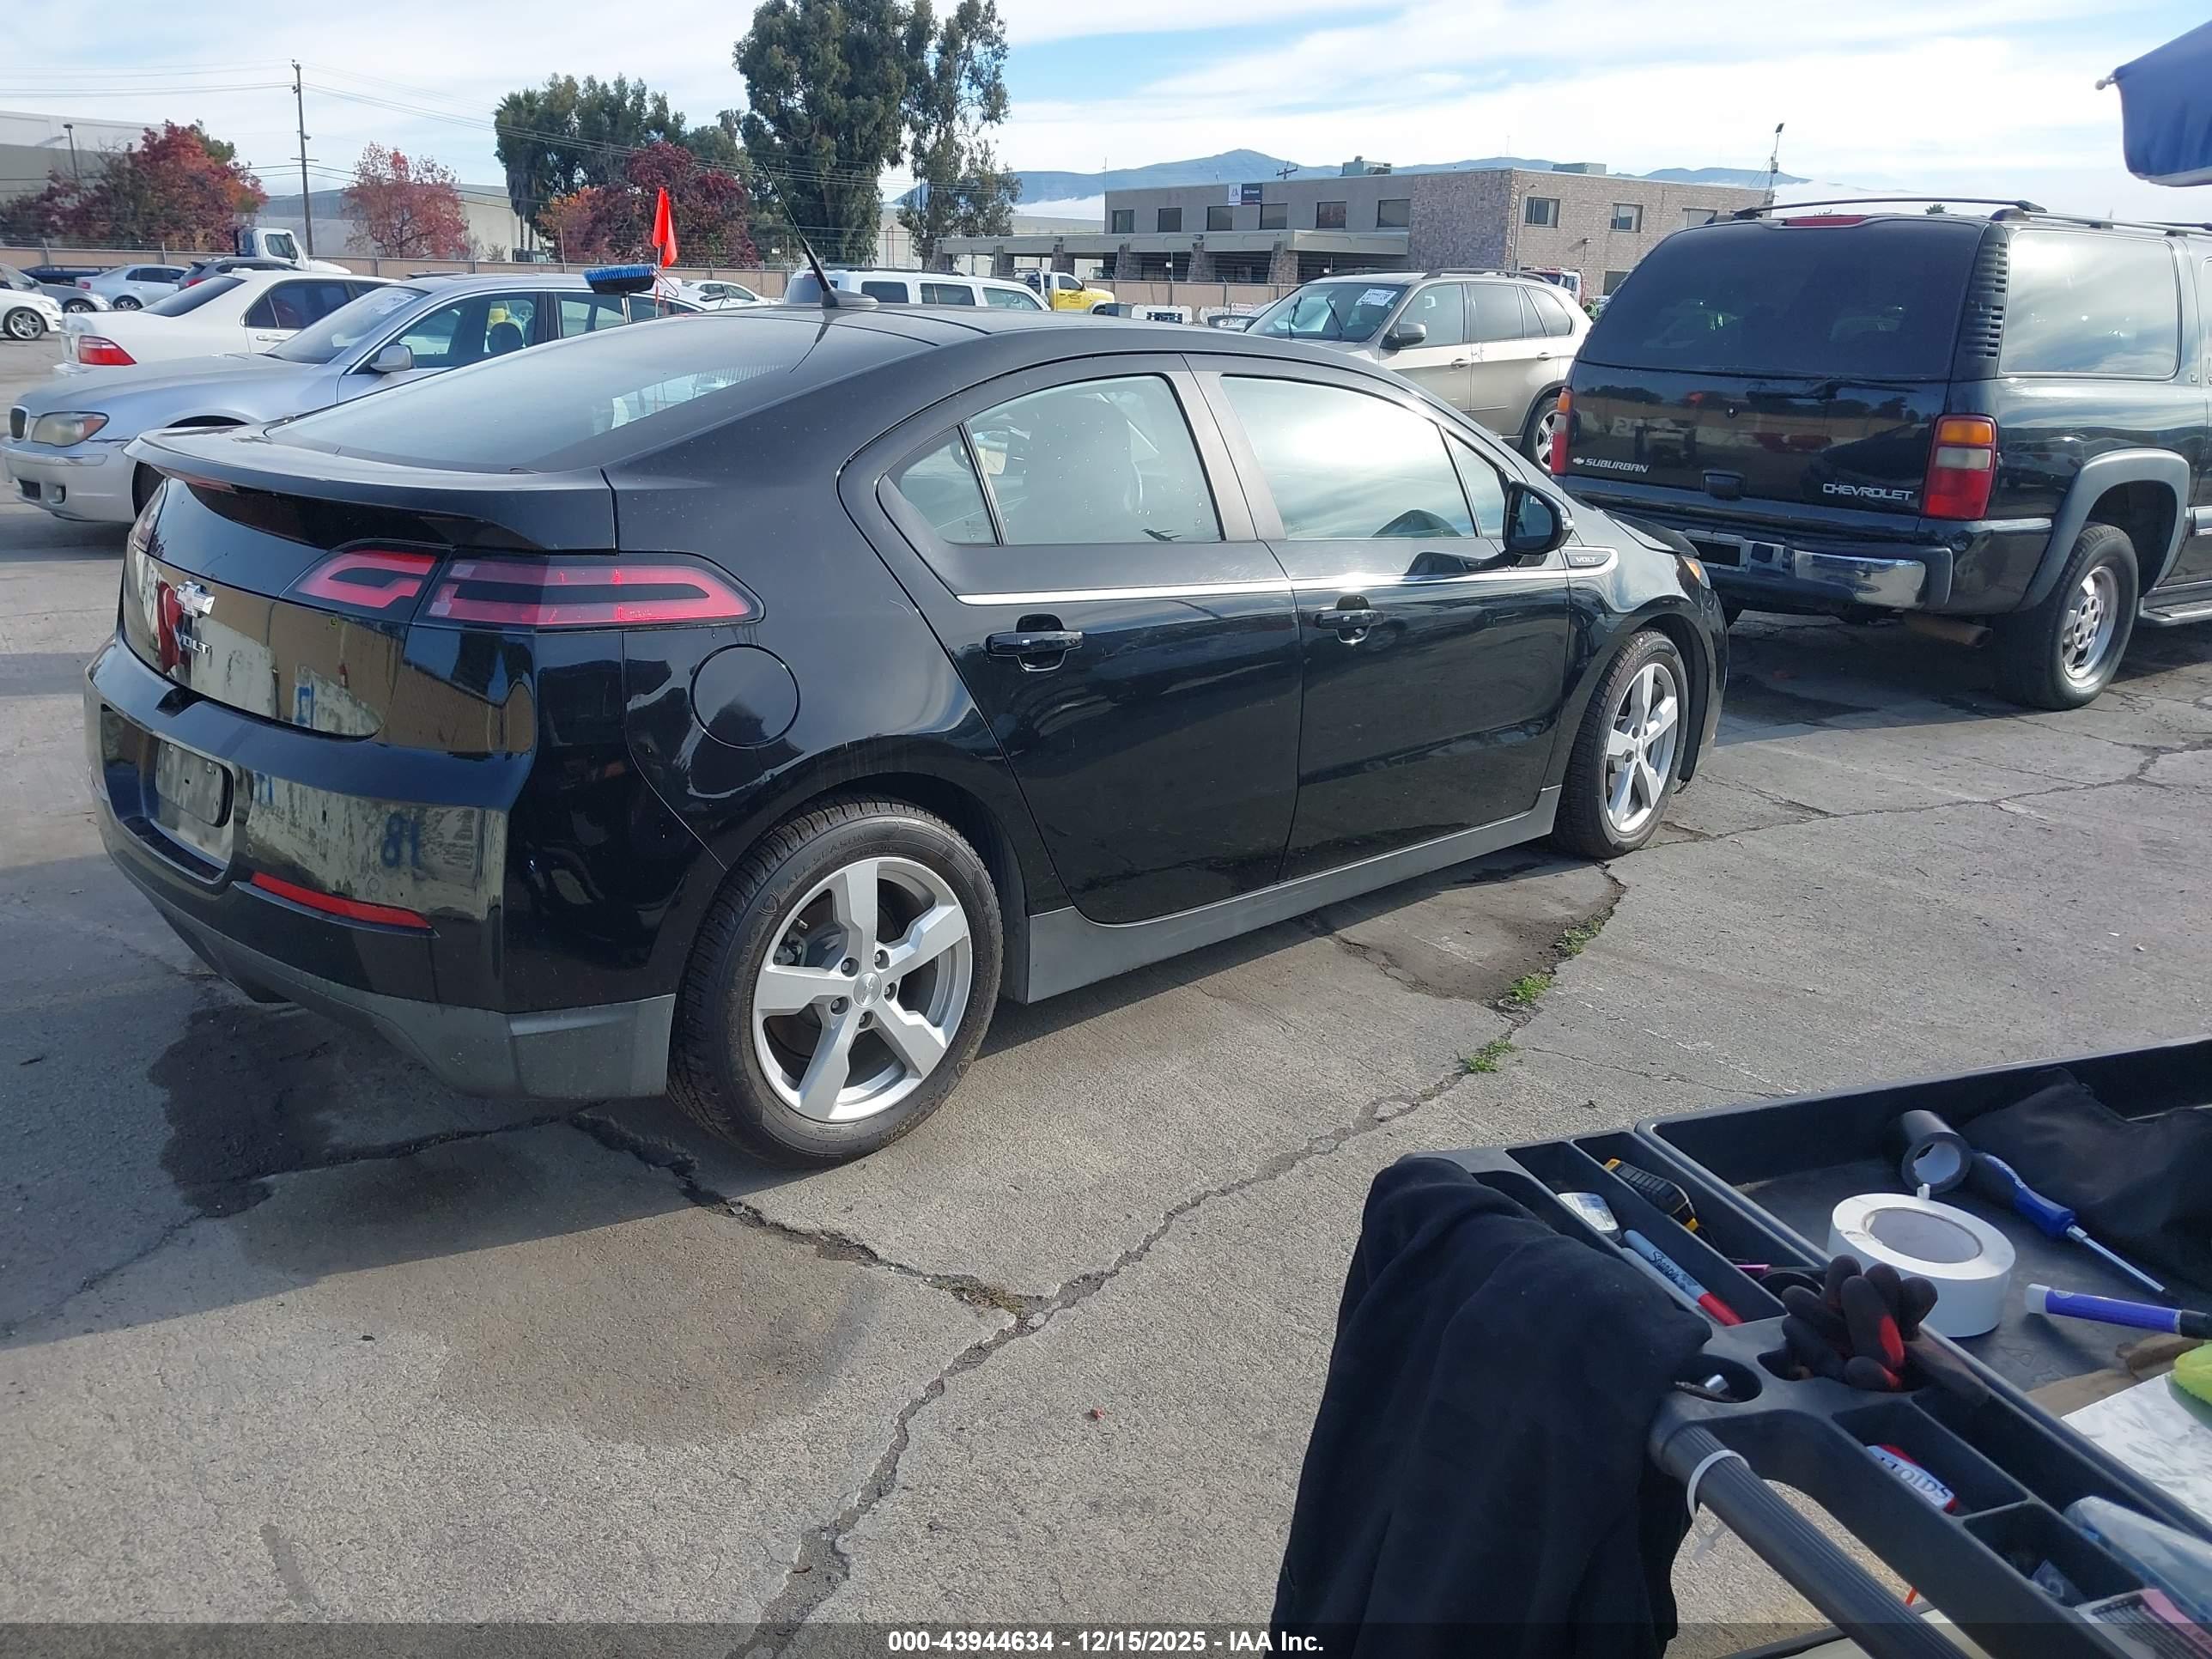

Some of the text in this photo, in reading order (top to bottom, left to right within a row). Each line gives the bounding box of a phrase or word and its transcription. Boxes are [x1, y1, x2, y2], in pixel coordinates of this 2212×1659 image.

[1585, 458, 1649, 473] SUBURBAN
[1823, 483, 1913, 501] CHEVROLET
[174, 631, 210, 653] VOLT
[1880, 1456, 1950, 1499] TOIDS
